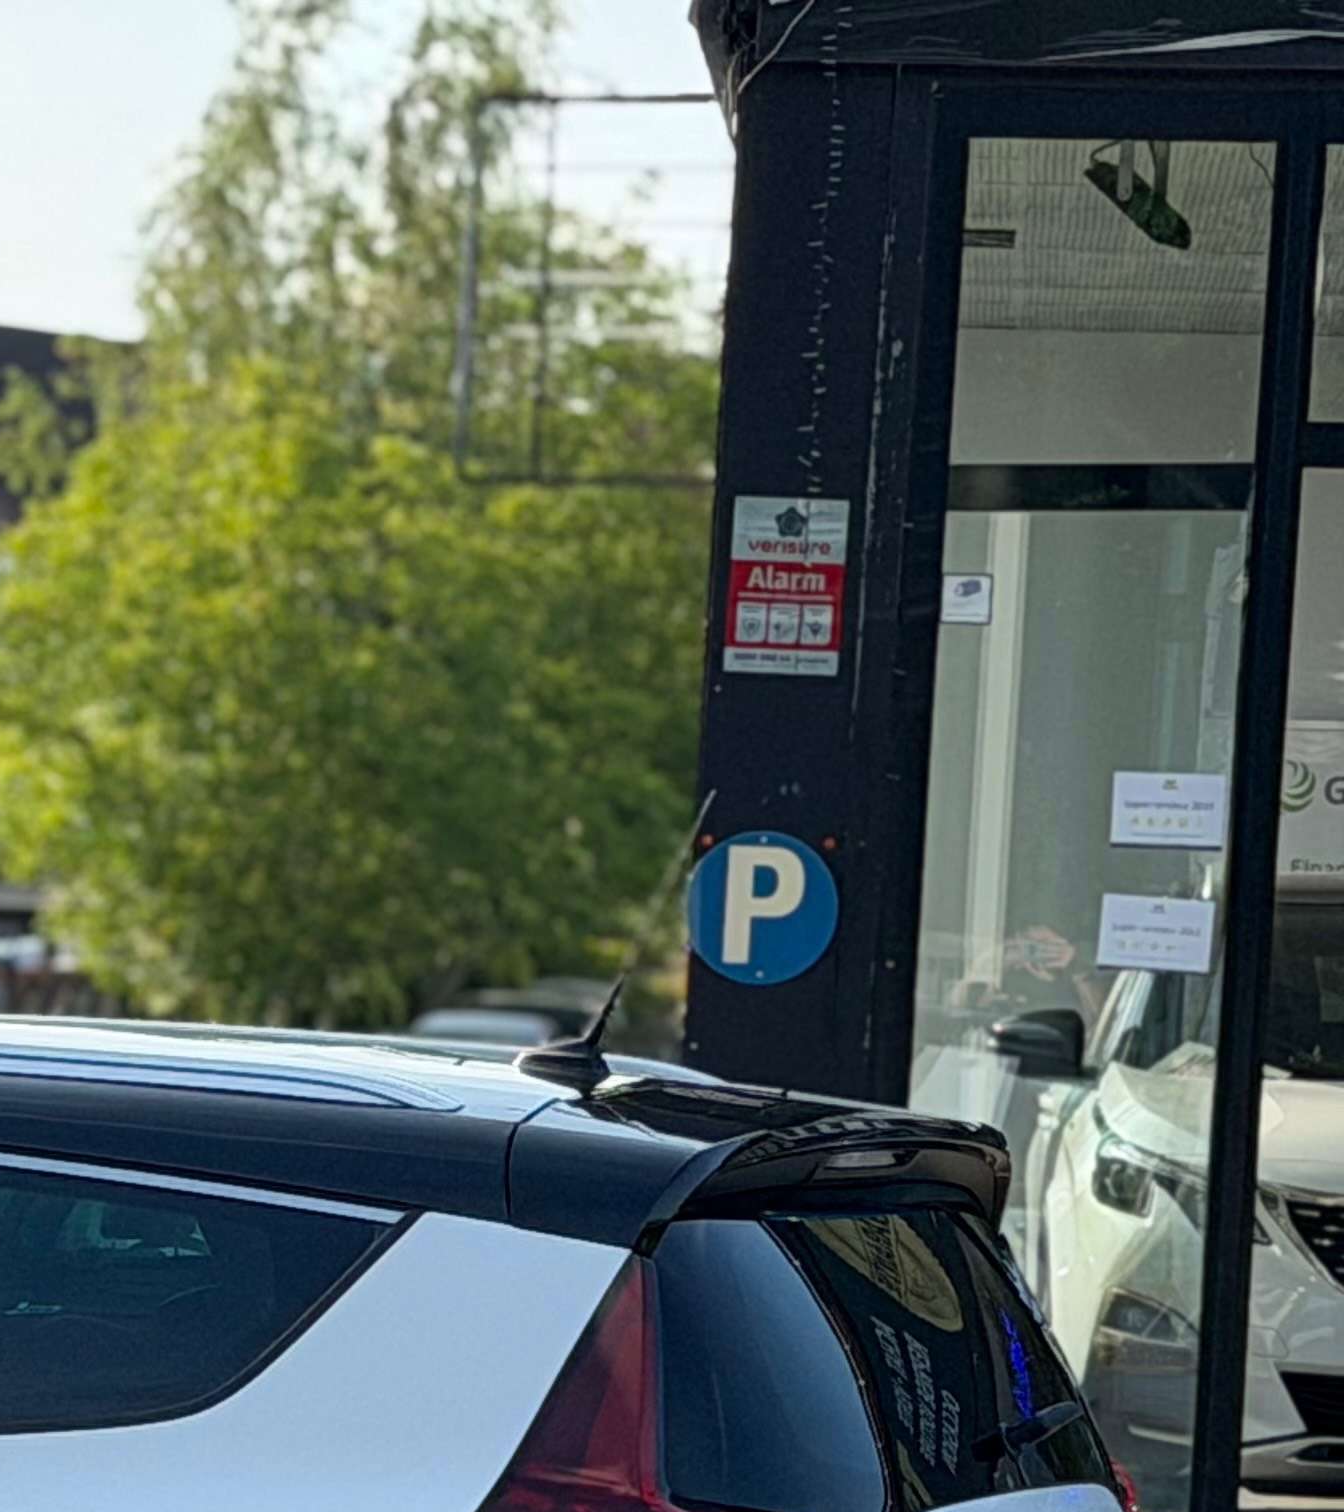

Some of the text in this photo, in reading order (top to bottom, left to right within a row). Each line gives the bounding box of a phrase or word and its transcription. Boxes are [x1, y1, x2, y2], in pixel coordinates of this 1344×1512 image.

[748, 539, 832, 555] verisure
[747, 565, 826, 592] Alarm
[721, 843, 806, 965] P
